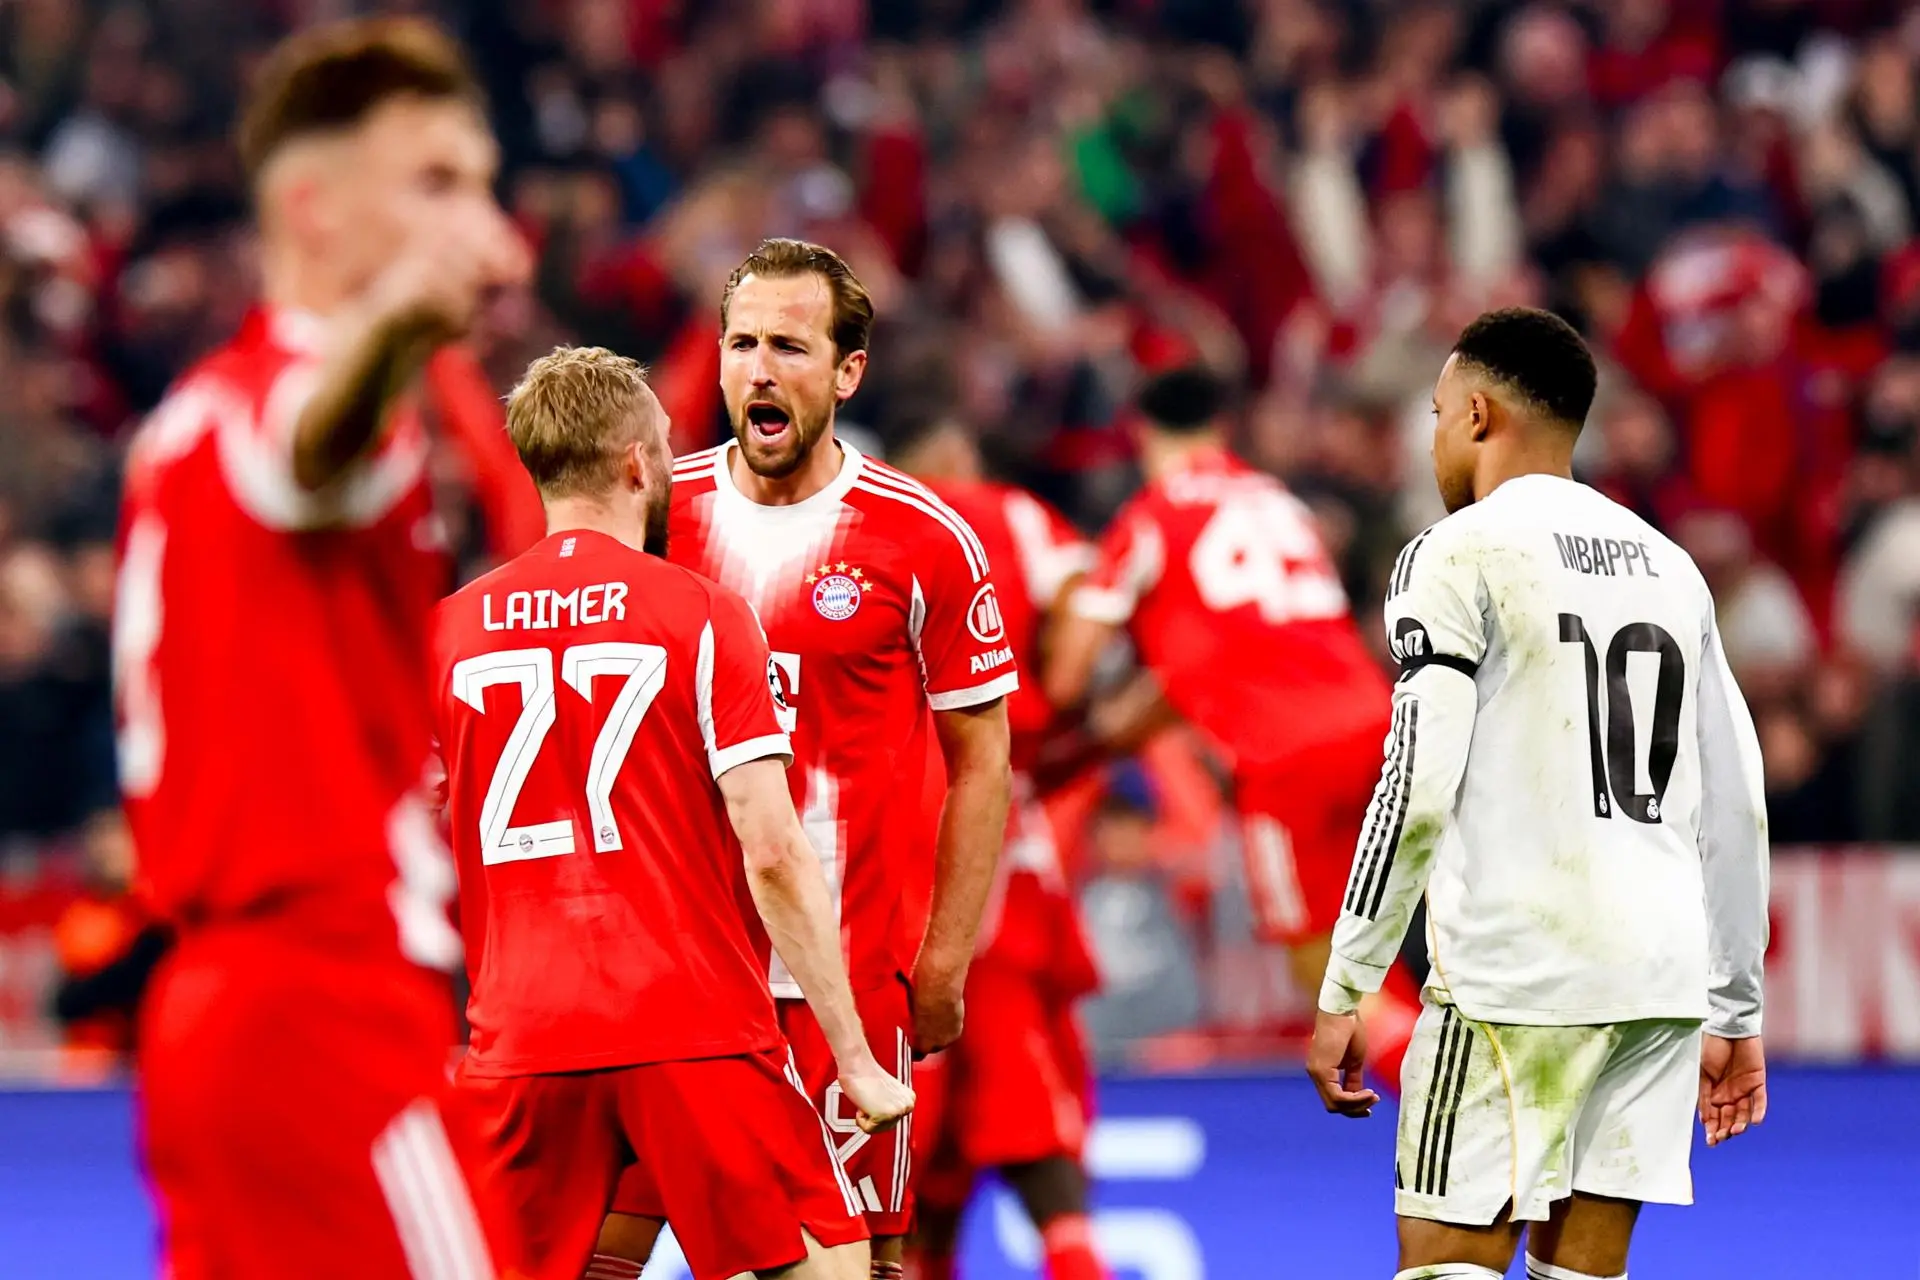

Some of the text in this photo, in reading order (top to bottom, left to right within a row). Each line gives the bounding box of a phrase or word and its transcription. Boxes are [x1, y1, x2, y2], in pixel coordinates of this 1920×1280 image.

[483, 581, 629, 631] LAIMER
[969, 645, 1015, 675] Allian
[452, 641, 668, 866] 27
[1558, 612, 1685, 824] 10
